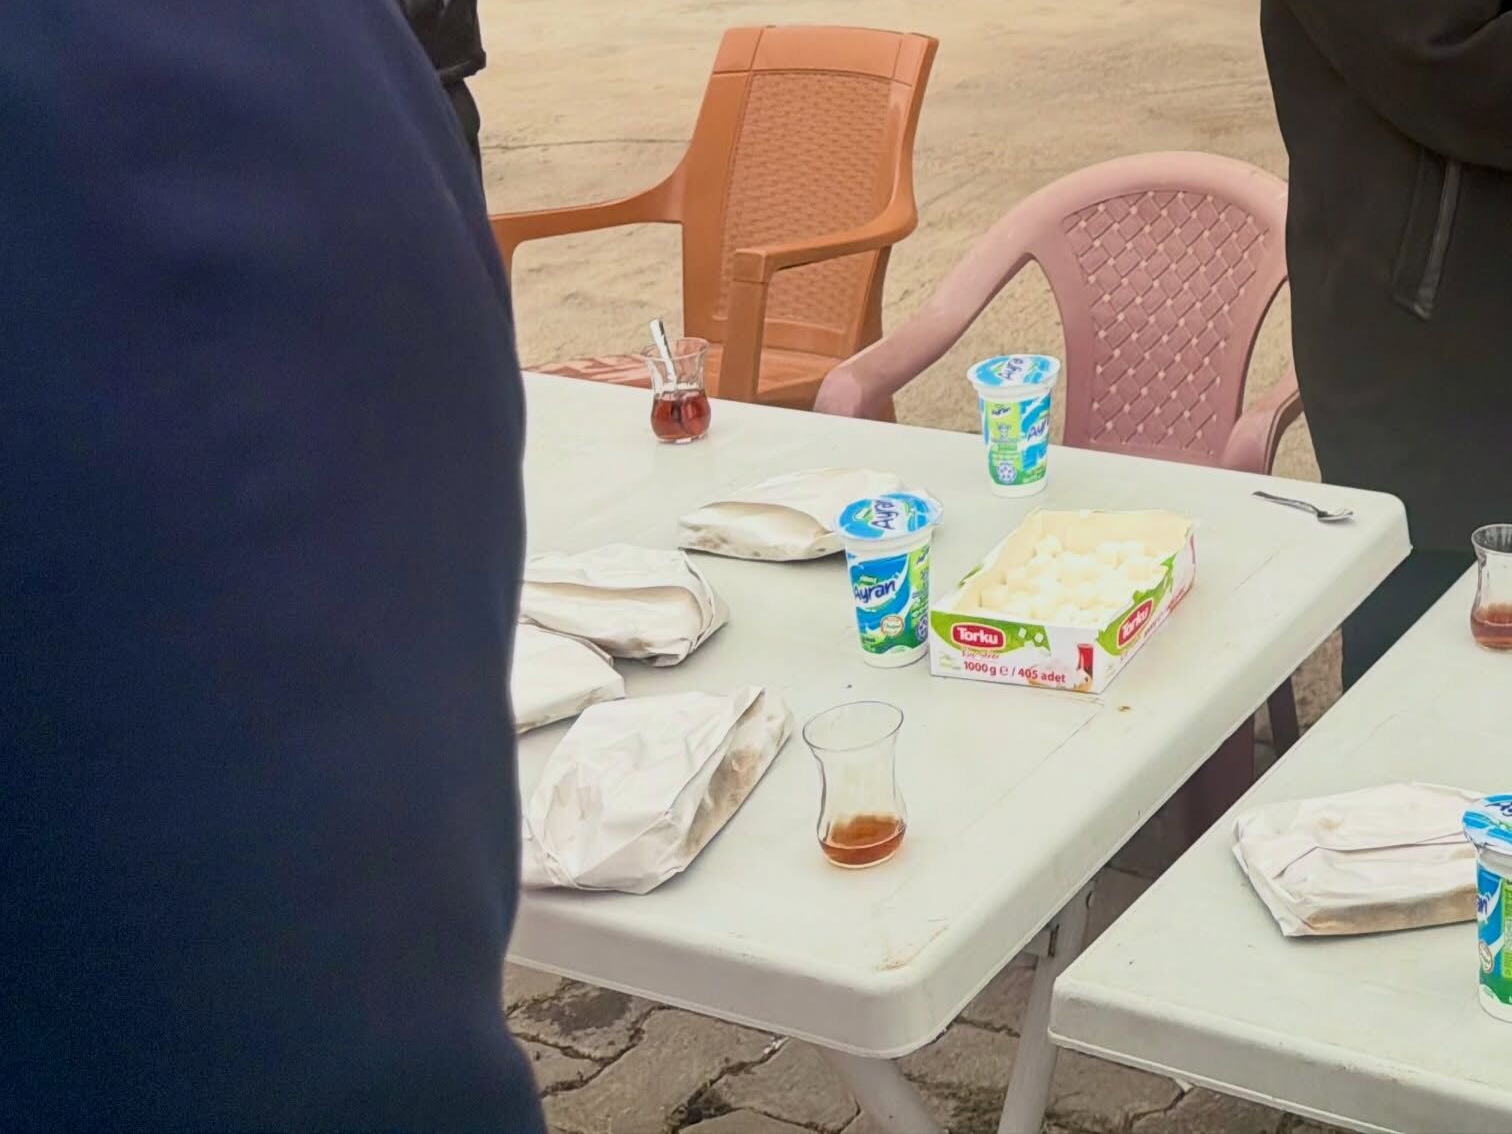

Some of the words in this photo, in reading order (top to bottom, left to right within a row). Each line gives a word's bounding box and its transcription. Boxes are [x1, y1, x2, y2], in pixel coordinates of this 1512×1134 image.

[871, 500, 899, 530] Ayra
[854, 580, 896, 604] Ayran
[1121, 607, 1149, 640] Torku
[957, 627, 998, 645] Torku
[963, 660, 988, 673] 1000
[1018, 668, 1039, 680] 405
[1041, 672, 1066, 683] adet
